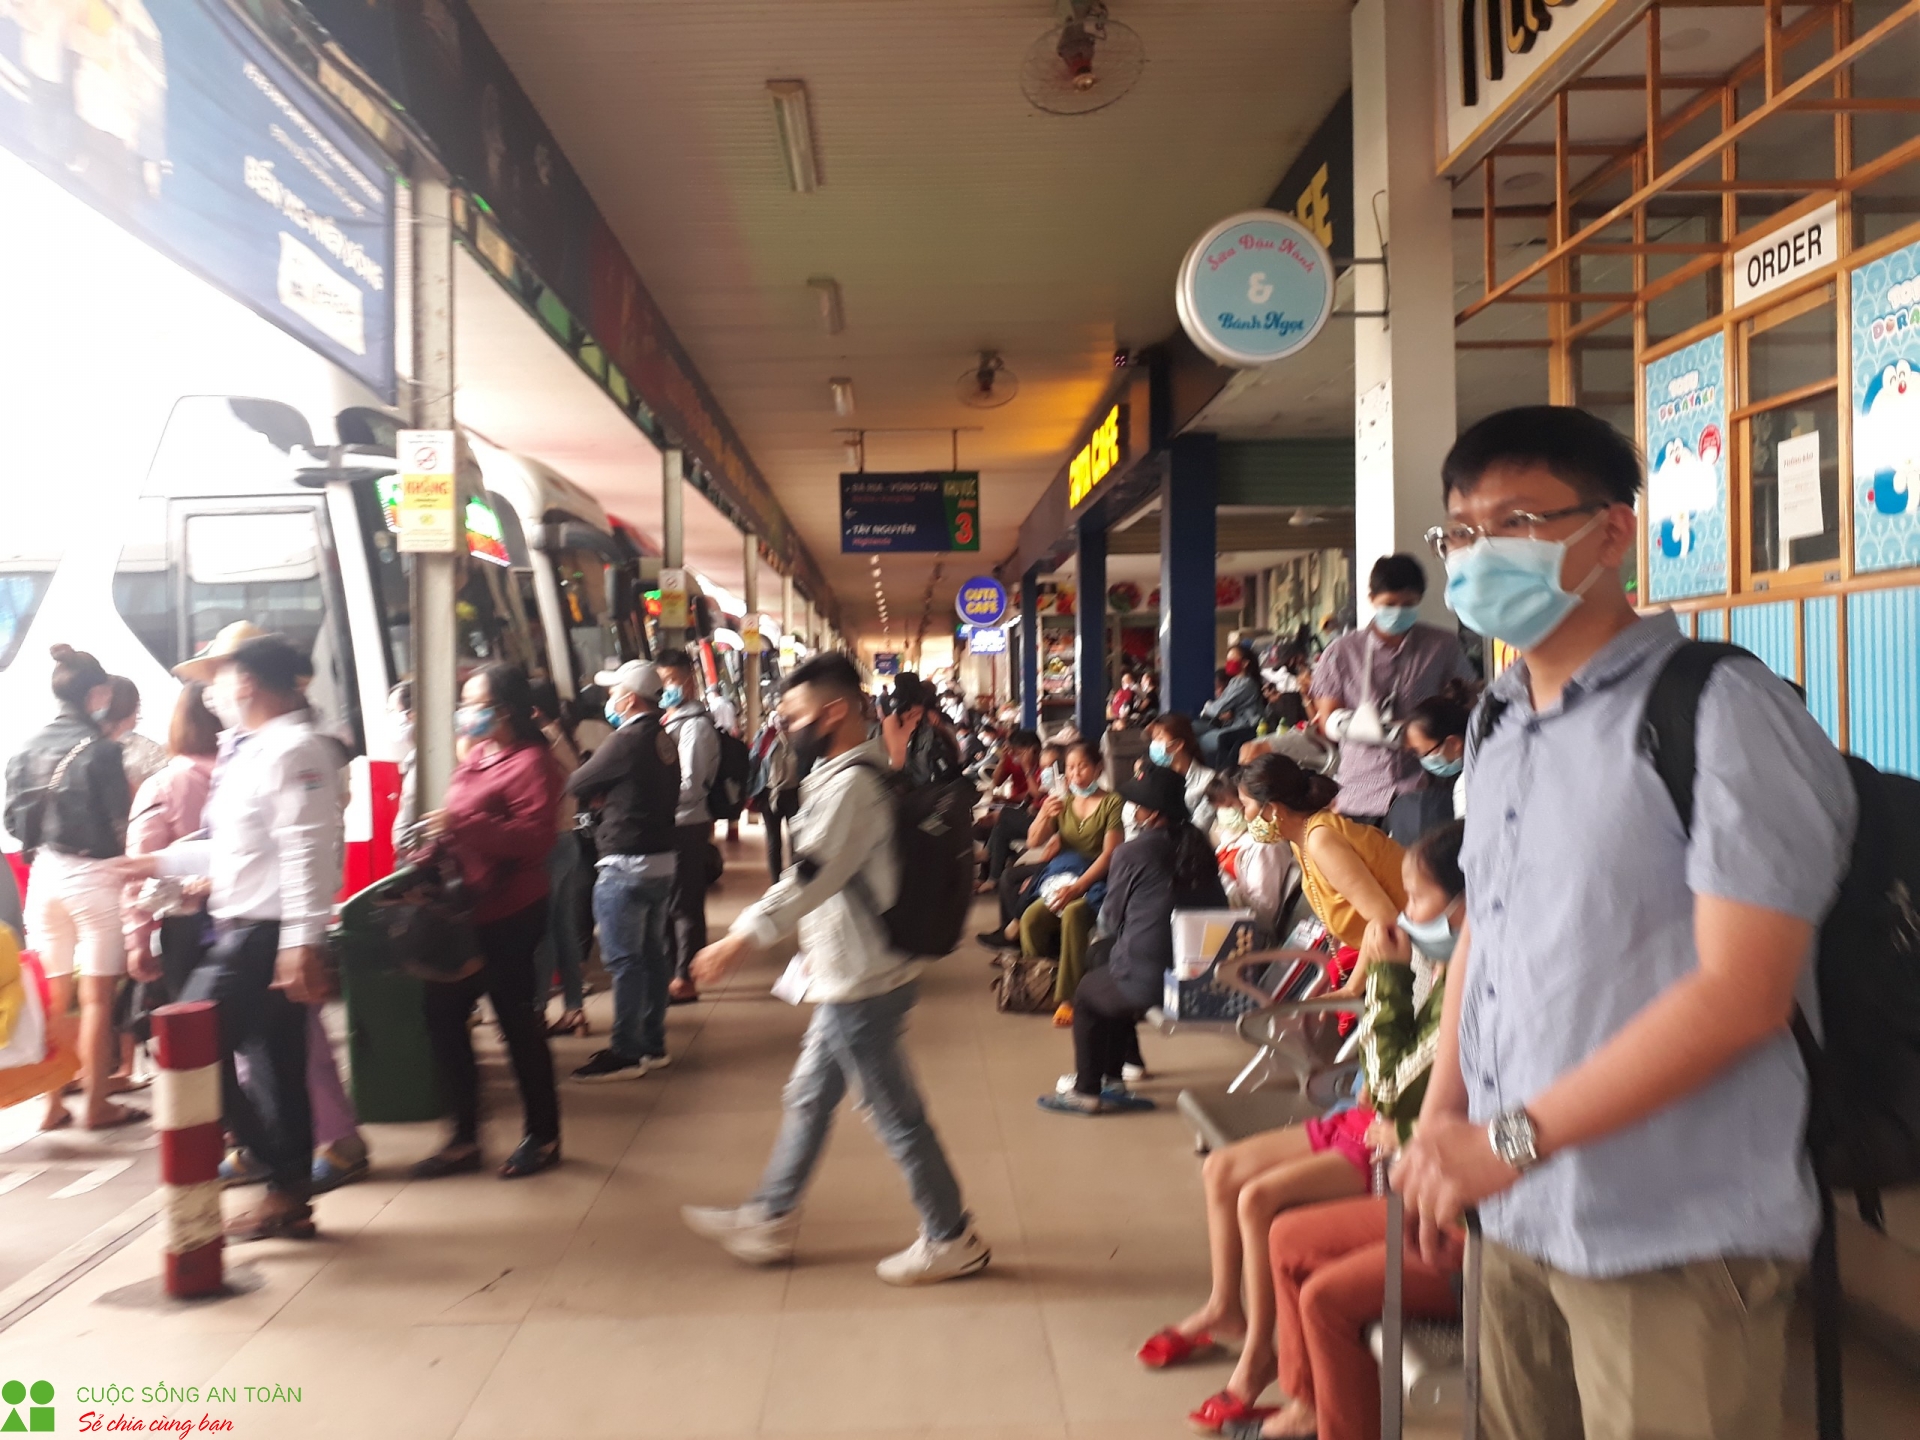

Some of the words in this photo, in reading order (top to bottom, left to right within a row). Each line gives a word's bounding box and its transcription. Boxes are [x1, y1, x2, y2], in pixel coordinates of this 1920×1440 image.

[1239, 234, 1275, 250] Đậu
[1748, 225, 1822, 287] ORDER
[1247, 272, 1274, 304] &
[1218, 311, 1261, 329] Bánh
[1659, 388, 1714, 420] DORAYAKI
[955, 512, 973, 544] 3
